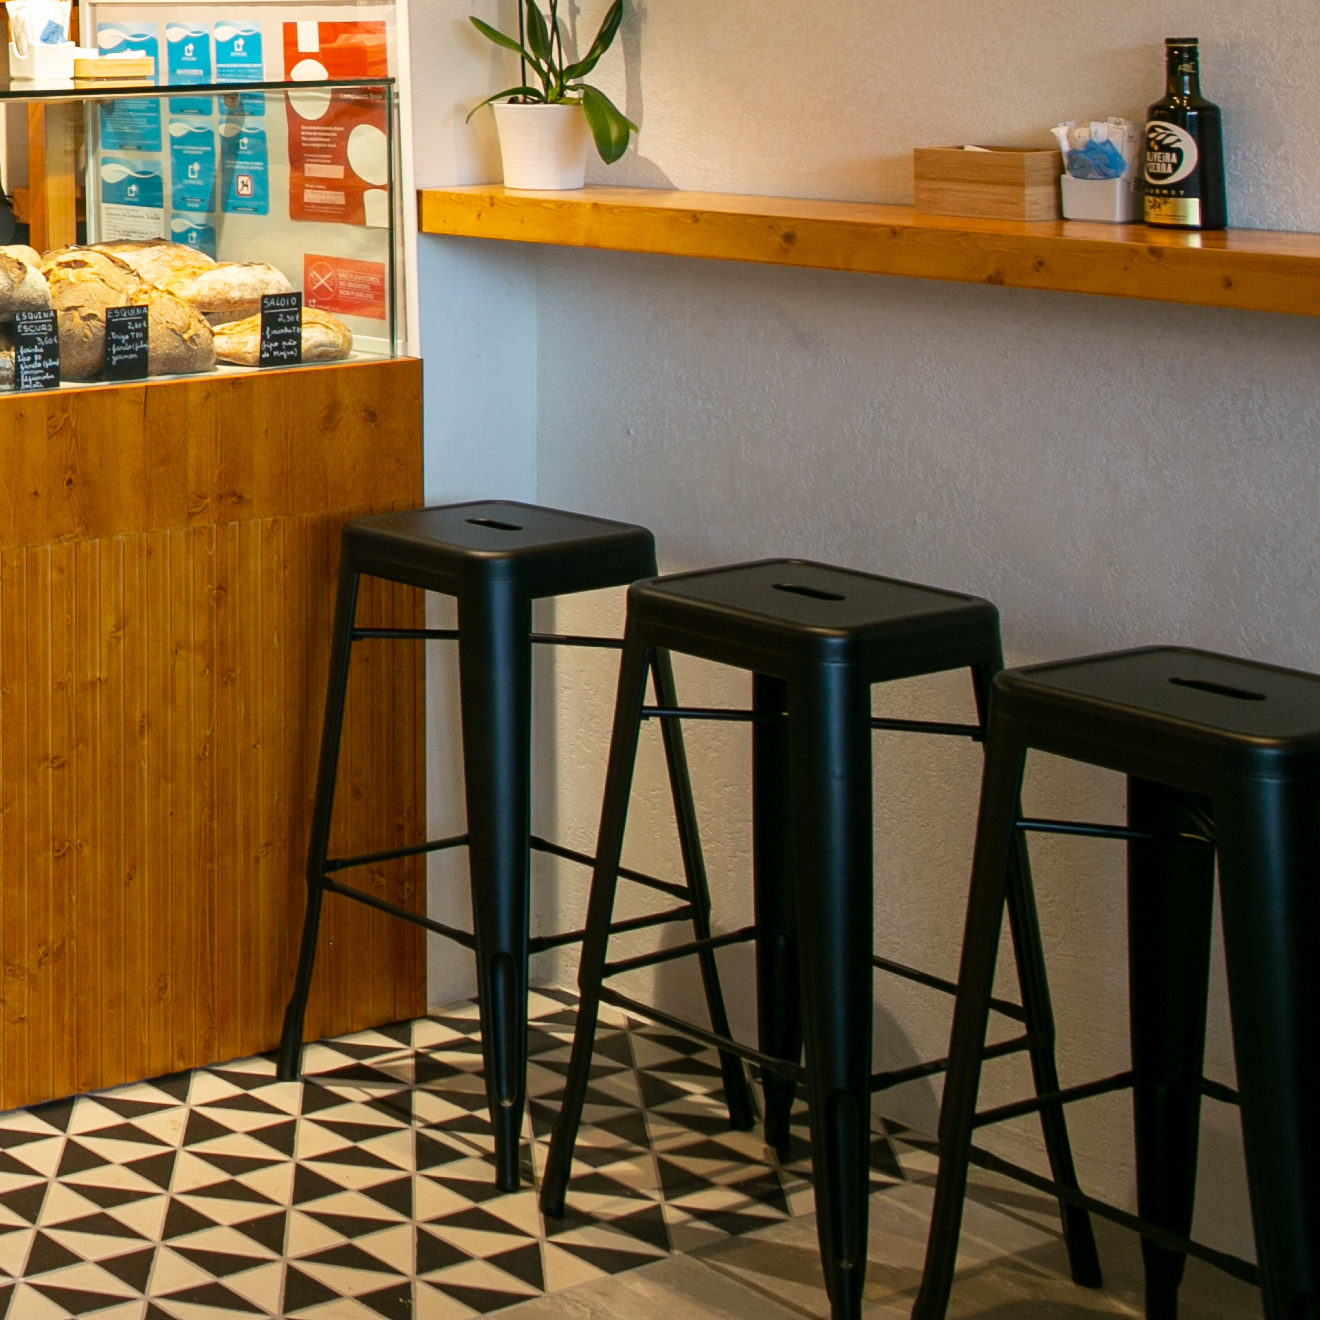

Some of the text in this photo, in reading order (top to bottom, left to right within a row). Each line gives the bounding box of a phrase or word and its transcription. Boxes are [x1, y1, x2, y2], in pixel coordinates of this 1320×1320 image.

[16, 310, 55, 321] ESQUINA
[107, 307, 147, 318] ESQUINA
[18, 324, 52, 332] ESCURO
